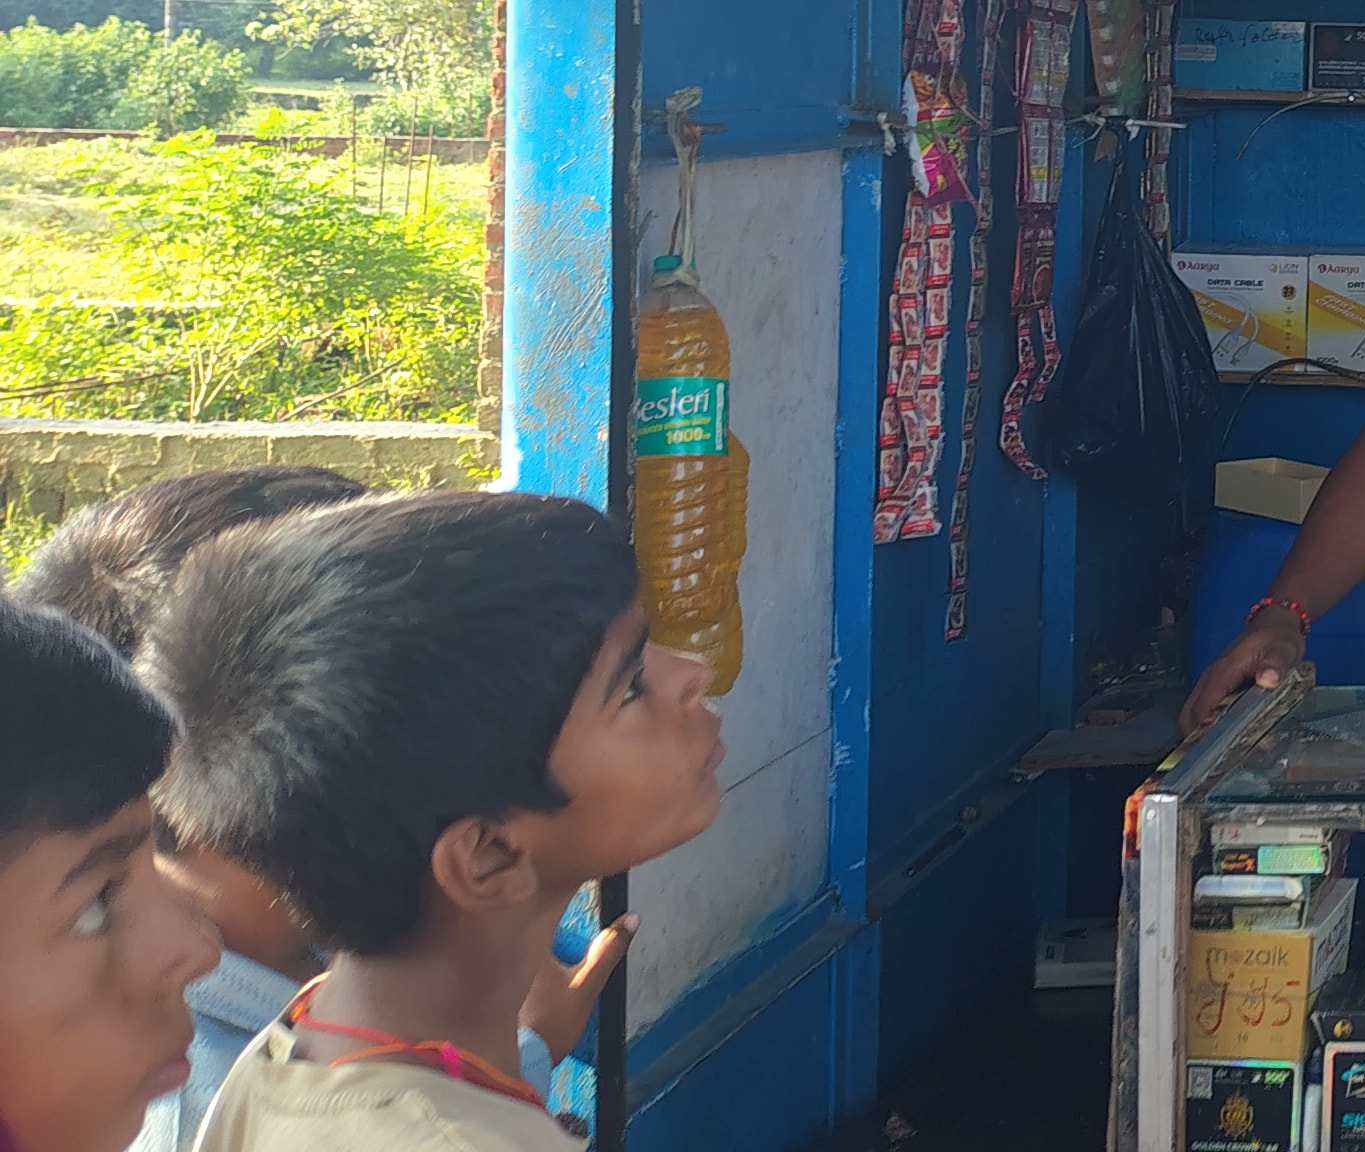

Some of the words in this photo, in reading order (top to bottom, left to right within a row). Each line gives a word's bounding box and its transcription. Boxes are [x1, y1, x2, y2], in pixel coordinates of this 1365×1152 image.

[1207, 279, 1232, 287] DATA
[1235, 279, 1264, 288] CABLE
[634, 387, 711, 423] esleri
